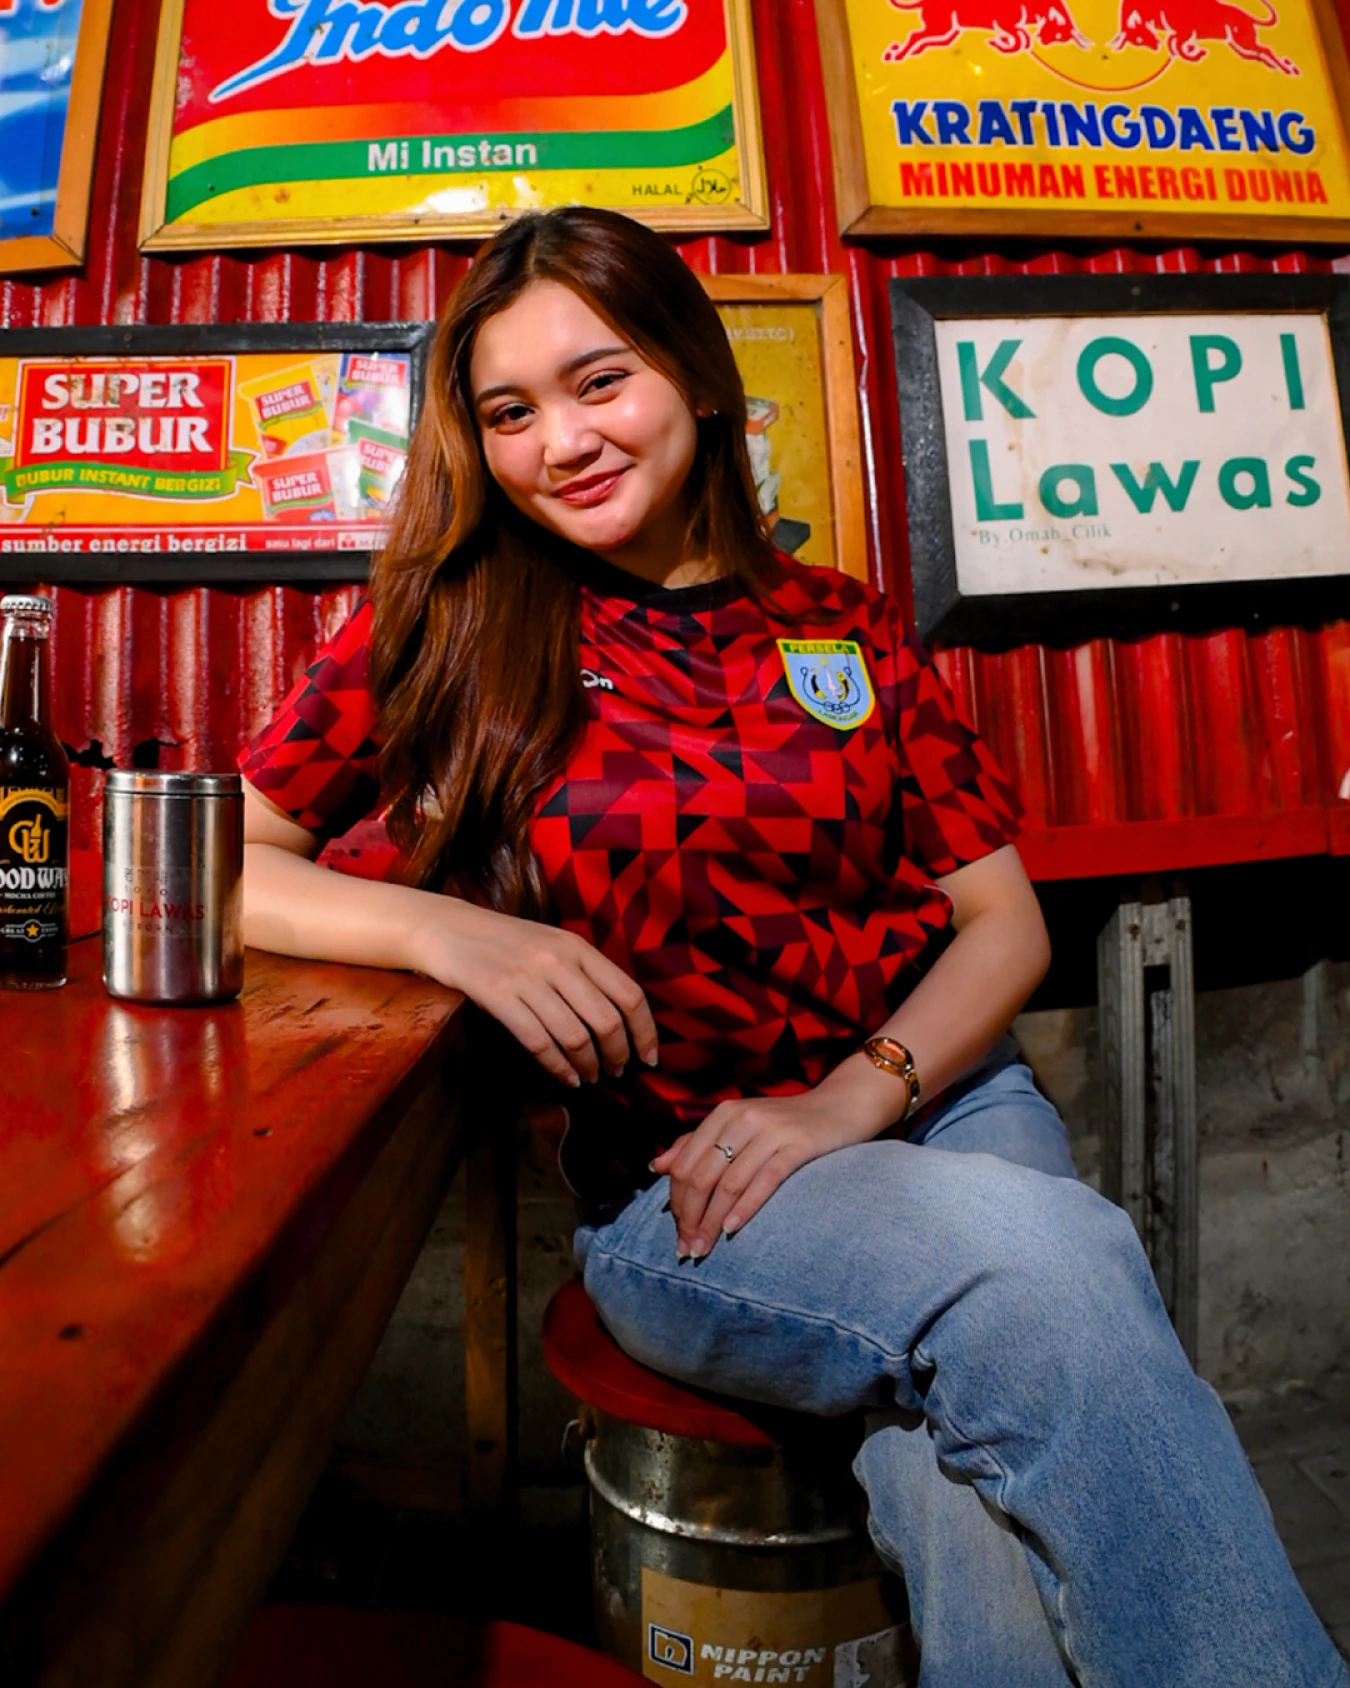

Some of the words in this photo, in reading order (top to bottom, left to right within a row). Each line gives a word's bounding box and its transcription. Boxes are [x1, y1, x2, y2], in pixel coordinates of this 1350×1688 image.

[892, 100, 1316, 155] KRATINGDAENG
[368, 141, 409, 171] Mi
[422, 139, 537, 168] Instan
[632, 184, 683, 196] HALAL
[900, 162, 1085, 198] MINUMAN
[1095, 164, 1217, 201] ENERGI
[1224, 168, 1328, 204] DUNIA
[956, 333, 1306, 421] KOPI
[41, 372, 205, 410] SUPER
[261, 384, 305, 406] SUPER
[30, 416, 214, 454] BUBUR
[80, 469, 151, 489] INSTANT
[155, 477, 221, 491] BERGIZI
[272, 471, 318, 490] SUPER
[968, 438, 1322, 522] Lawas
[272, 483, 322, 502] BUBUR
[1, 534, 84, 552] sumber
[89, 534, 161, 552] energi
[168, 533, 247, 552] bergizi
[140, 901, 206, 920] LAWAS
[700, 1643, 827, 1666] NIPPON
[713, 1663, 811, 1684] PAINT
